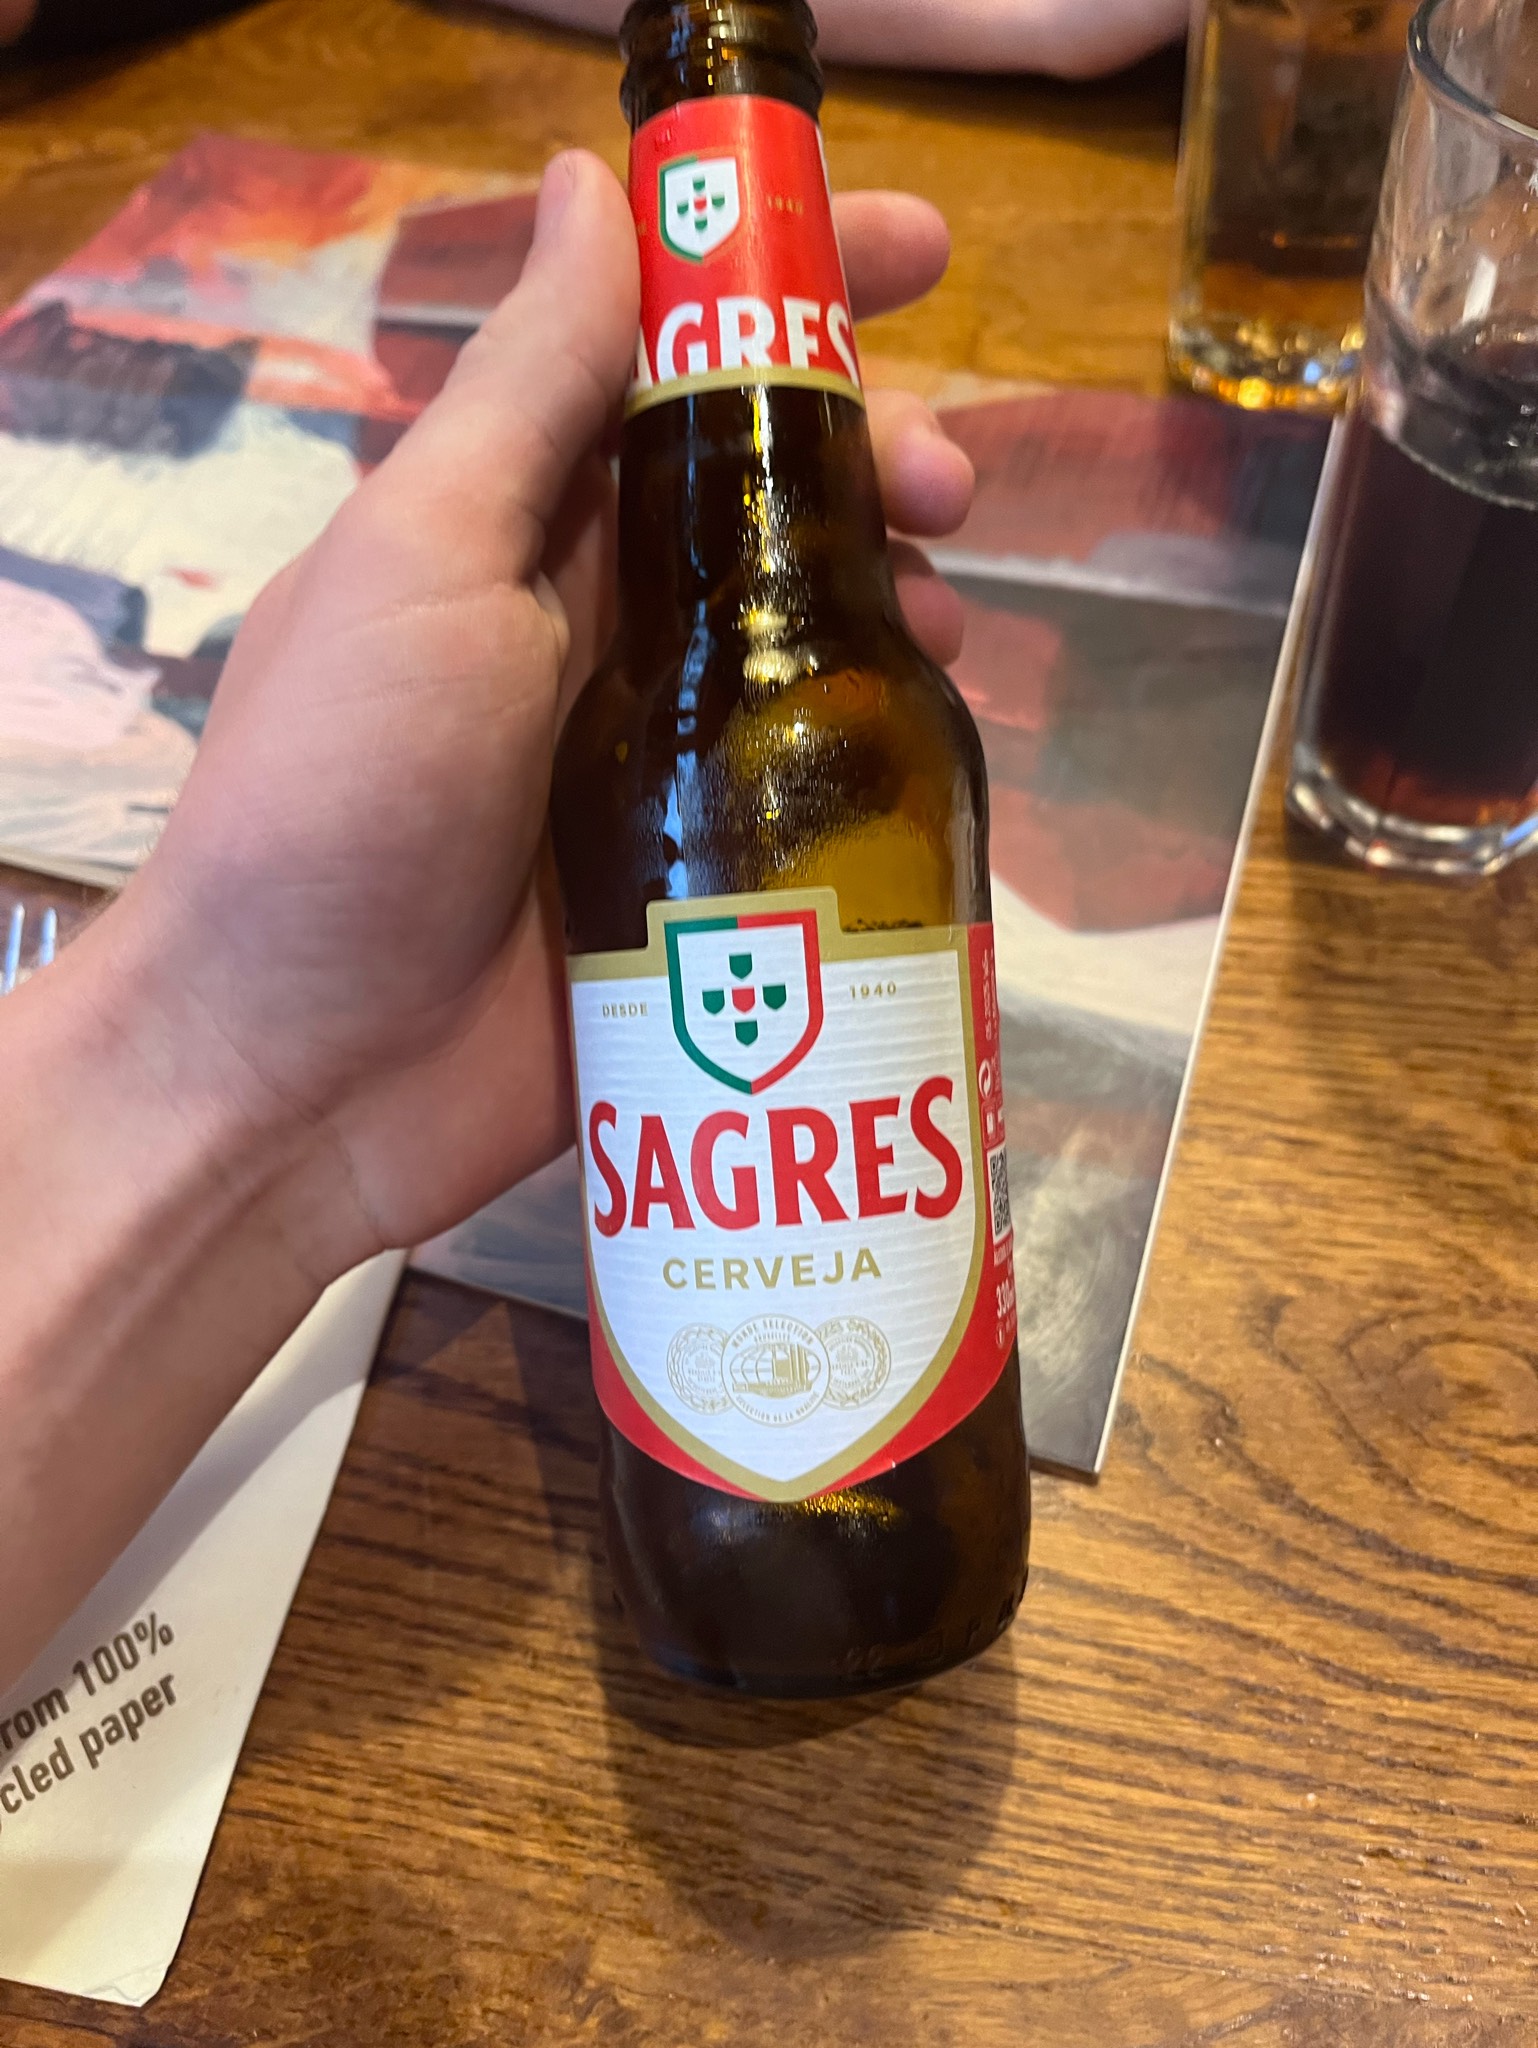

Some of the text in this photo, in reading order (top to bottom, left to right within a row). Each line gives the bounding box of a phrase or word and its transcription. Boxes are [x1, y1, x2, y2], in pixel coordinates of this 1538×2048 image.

[602, 1002, 649, 1018] DESDE
[850, 981, 897, 1000] 1940
[589, 1075, 963, 1238] SAGRES
[662, 1247, 882, 1290] CERVEJA
[0, 1611, 174, 1751] rom 100%
[79, 1673, 176, 1770] paper
